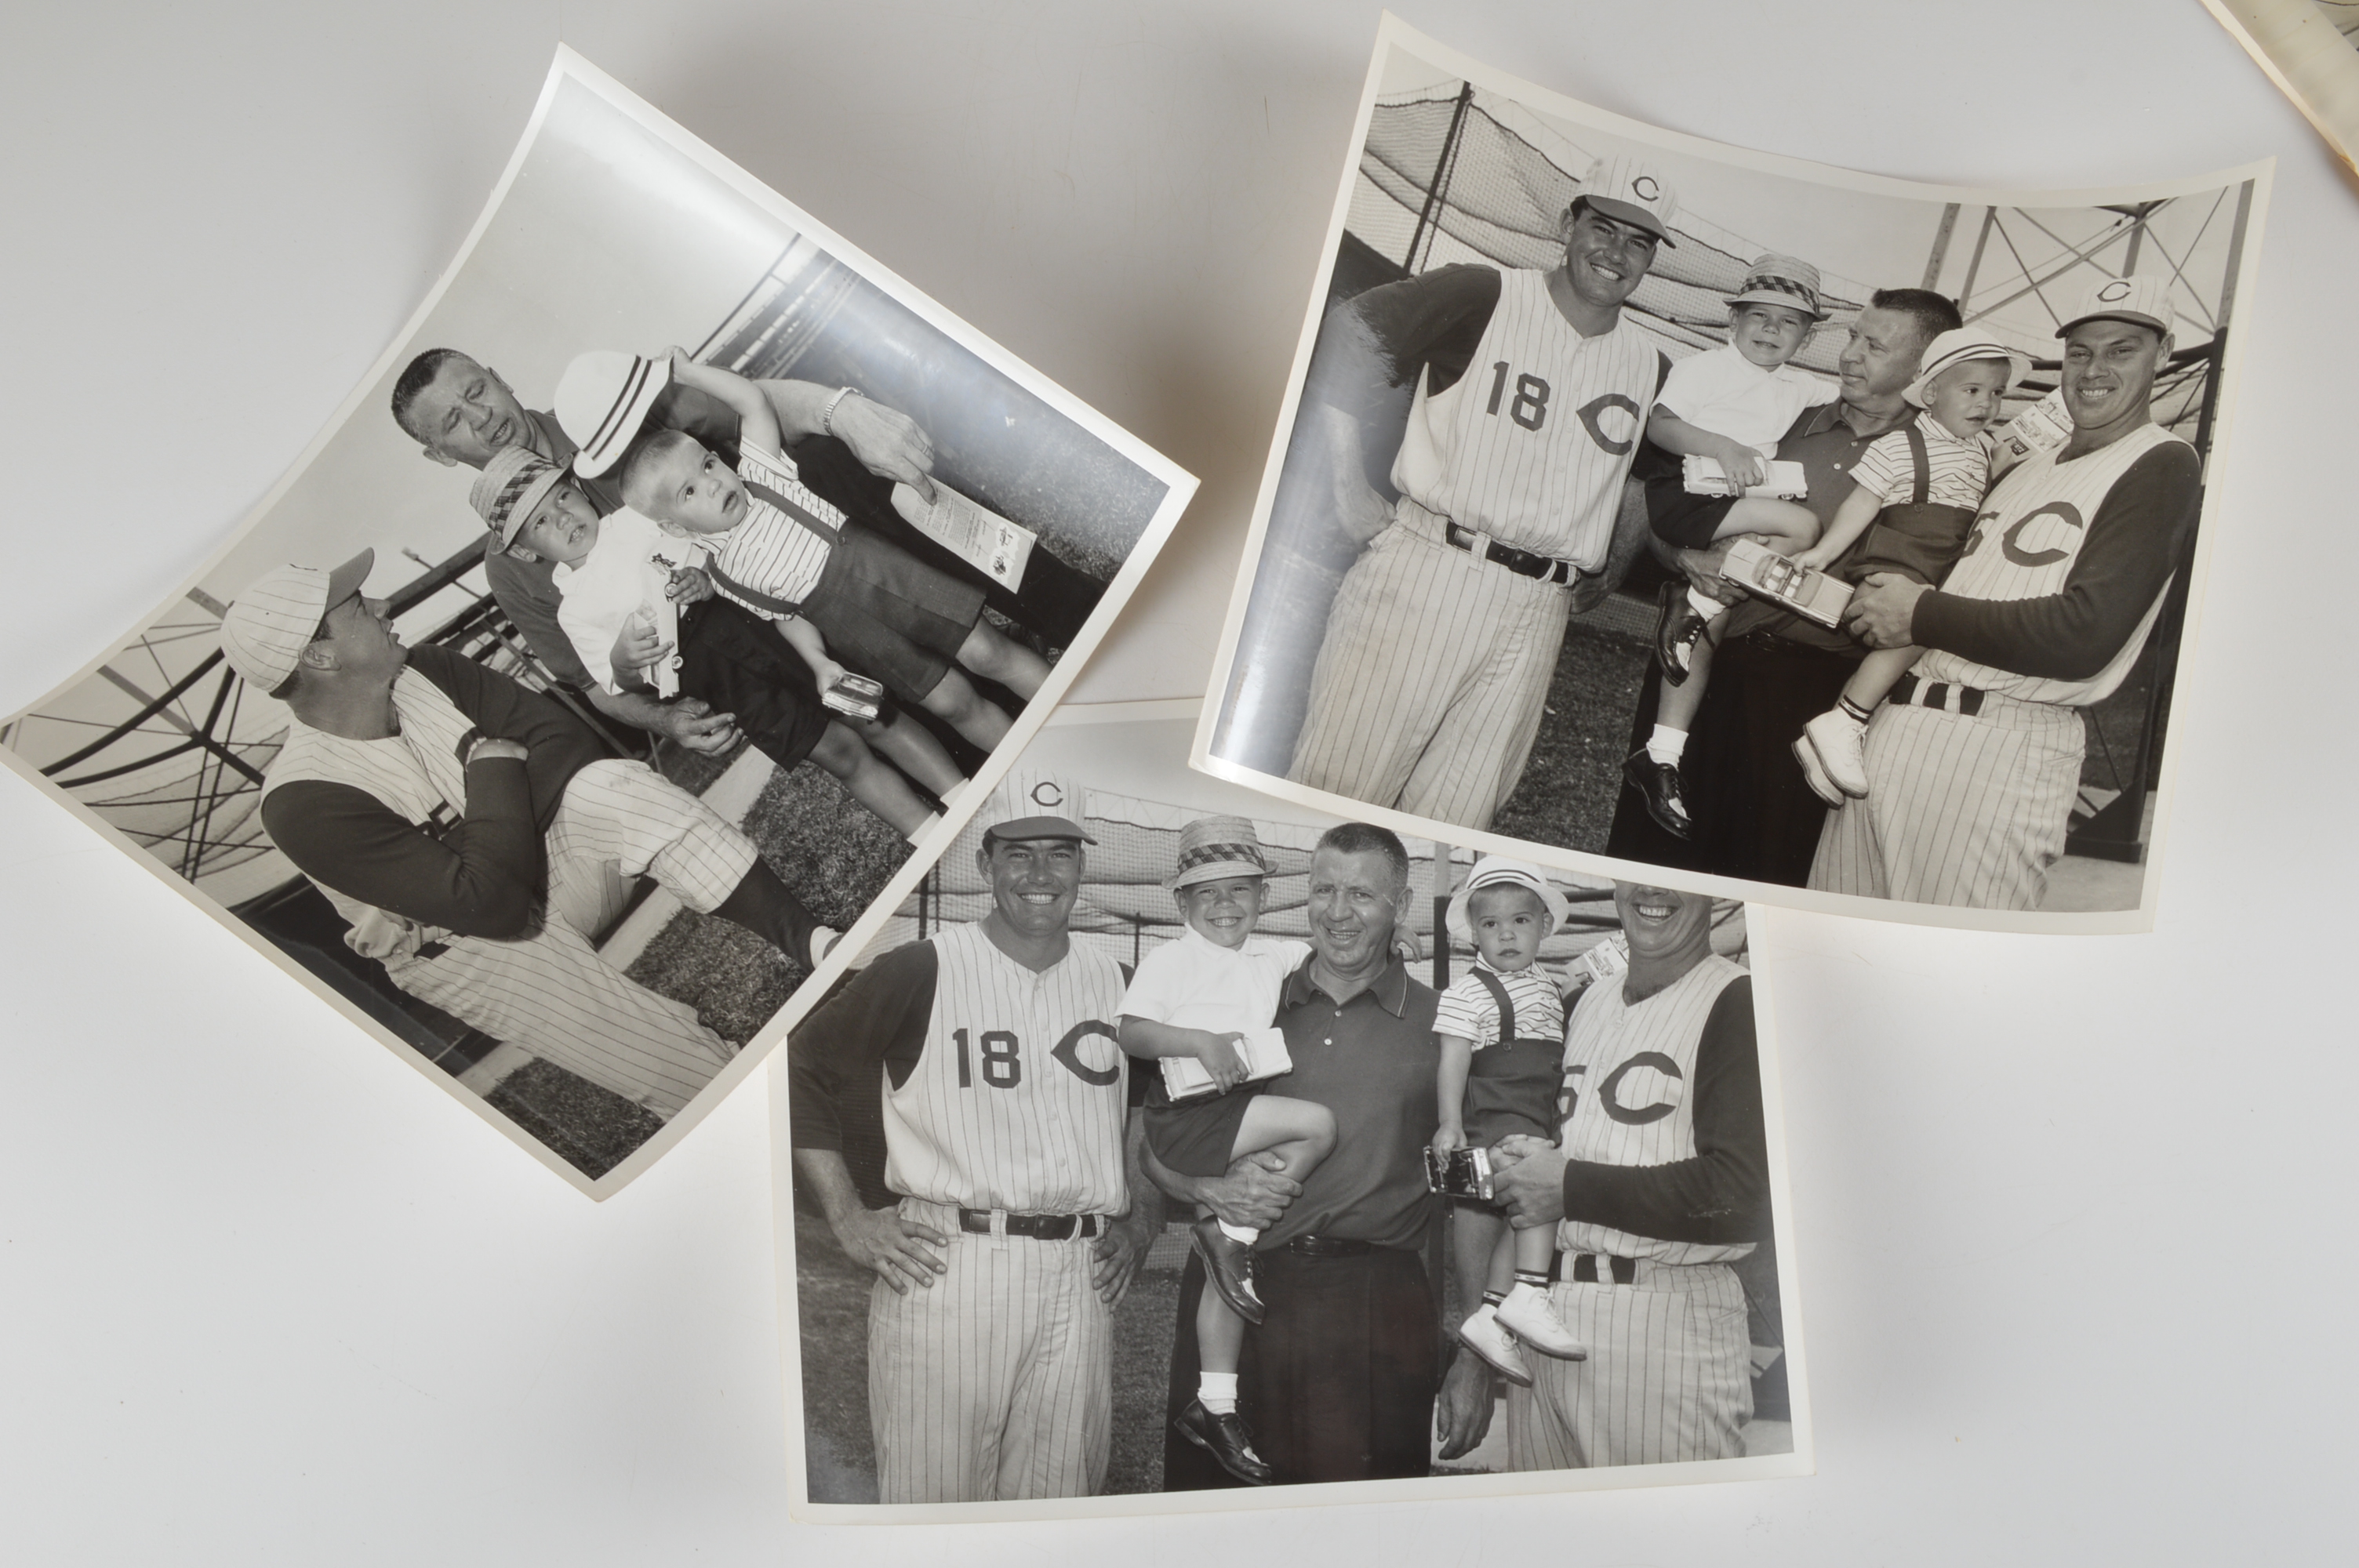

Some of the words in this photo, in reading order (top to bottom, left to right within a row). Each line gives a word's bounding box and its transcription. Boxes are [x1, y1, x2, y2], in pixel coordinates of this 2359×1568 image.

[1631, 176, 1659, 201] C
[2097, 281, 2132, 302] C
[1487, 361, 1551, 432] 18
[1576, 394, 1641, 456] C
[2001, 501, 2084, 568] C
[1030, 781, 1063, 808] C
[952, 1028, 1022, 1089] 18
[1049, 1019, 1120, 1087] C
[1597, 1051, 1684, 1126] C
